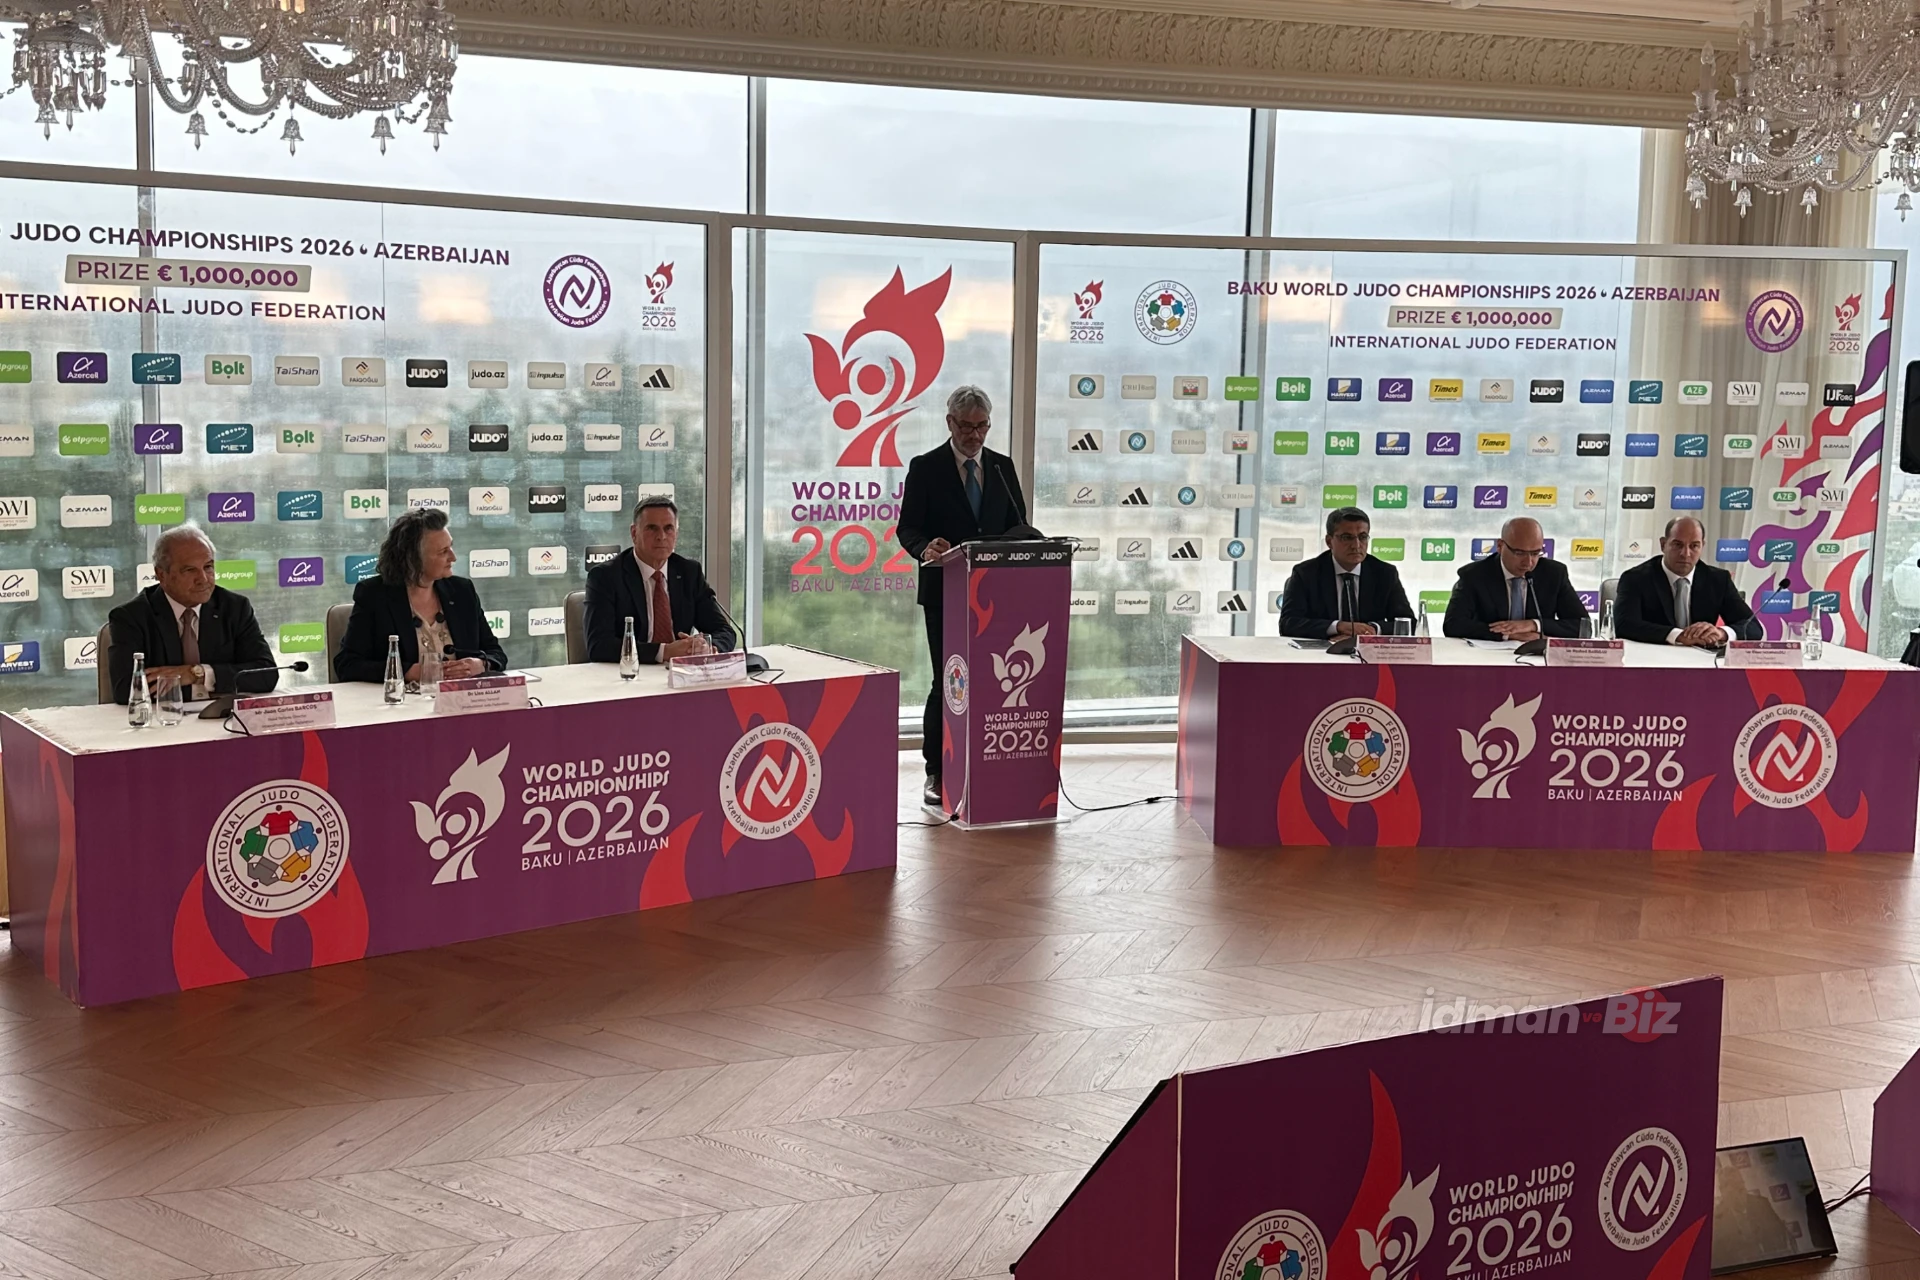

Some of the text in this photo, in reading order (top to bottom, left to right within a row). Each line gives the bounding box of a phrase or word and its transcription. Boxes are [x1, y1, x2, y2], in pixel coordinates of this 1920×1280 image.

[10, 222, 510, 266] JUDO CHAMPIONSHIPS 2026 AZERBAIJAN
[77, 261, 298, 288] PRIZE € 1,000,000
[1228, 281, 1720, 302] BAKU WORLD JUDO CHAMPIONSHIPS 2026 AZERBAIJAN
[0, 293, 386, 321] TERNATIONAL JUDO FEDERATION
[642, 316, 676, 327] 2026
[1396, 310, 1552, 327] PRIZE € 1,000,000
[1070, 330, 1104, 341] 2026
[1330, 336, 1617, 350] INTERNATIONAL JUDO FEDERATION
[1829, 341, 1860, 351] 2026
[67, 371, 99, 379] Azercell
[211, 360, 245, 379] Bolt
[276, 366, 319, 376] TaiShan
[471, 369, 505, 380] judo.az
[1281, 382, 1305, 396] Bolt
[1434, 385, 1458, 393] Times
[1686, 386, 1703, 394] AZE
[1732, 385, 1756, 396] SWI
[283, 430, 315, 447] Bolt
[345, 434, 386, 443] TaiShan
[531, 433, 563, 443] judo.az
[1330, 436, 1354, 450] Bolt
[1481, 439, 1506, 447] Times
[1731, 440, 1747, 448] AZE
[1777, 437, 1800, 449] SWI
[144, 442, 175, 450] Azercell
[588, 493, 618, 503] judo.az
[793, 482, 881, 500] WORLD
[1378, 490, 1402, 504] Bolt
[1528, 492, 1553, 500] Times
[1776, 493, 1792, 501] AZE
[1821, 491, 1844, 502] SWI
[351, 496, 381, 512] Bolt
[409, 498, 448, 507] TaiShan
[217, 510, 246, 518] Azercell
[791, 504, 901, 521] CHAMPIO
[791, 525, 913, 575] 202
[1426, 542, 1450, 557] Bolt
[1575, 545, 1599, 553] Times
[471, 560, 508, 568] TaiShan
[71, 569, 106, 585] SWI
[287, 575, 316, 583] Azercell
[791, 577, 917, 592] BAKU AZERBA
[985, 711, 1049, 722] WORLD JUDO
[1777, 707, 1798, 715] Cüdo
[984, 720, 1049, 731] CHAMPIONSHIPS
[1552, 715, 1687, 731] WORLD JUDO
[983, 729, 1048, 753] 2026
[1550, 732, 1686, 747] CHAMPIONSHIPS
[725, 727, 815, 777] Azərbaycan Cüdo Federasiyası
[1006, 750, 1048, 759] AZERBAIJAN
[1312, 706, 1401, 793] INTERNATIONAL JUDO FEDERATION
[523, 751, 670, 784] WORLD JUDO
[1549, 749, 1684, 788] 2026
[522, 770, 669, 804] CHAMPIONSHIPS
[1739, 767, 1830, 804] Azerbaijan Judo Federation
[1548, 789, 1683, 802] BAKU AZERBAIJAN
[726, 788, 815, 835] Azerbaijan Judo Federation
[522, 791, 670, 854] 2026
[218, 790, 339, 908] INTERNATIONAL JUDO FEDERATION
[522, 837, 669, 871] BAKU AZERBAIJAN
[1604, 1132, 1683, 1188] Azərbaycan Cüdo Federasiyası
[1450, 1161, 1575, 1205] WORLD JUDO
[1448, 1181, 1574, 1225] CHAMPIONSHIPS
[1604, 1193, 1681, 1246] Azerbaijan Judo Federation
[1257, 1220, 1289, 1235] JUDO
[1447, 1203, 1573, 1276] 2026
[1491, 1249, 1571, 1280] AZERBAIJAN
